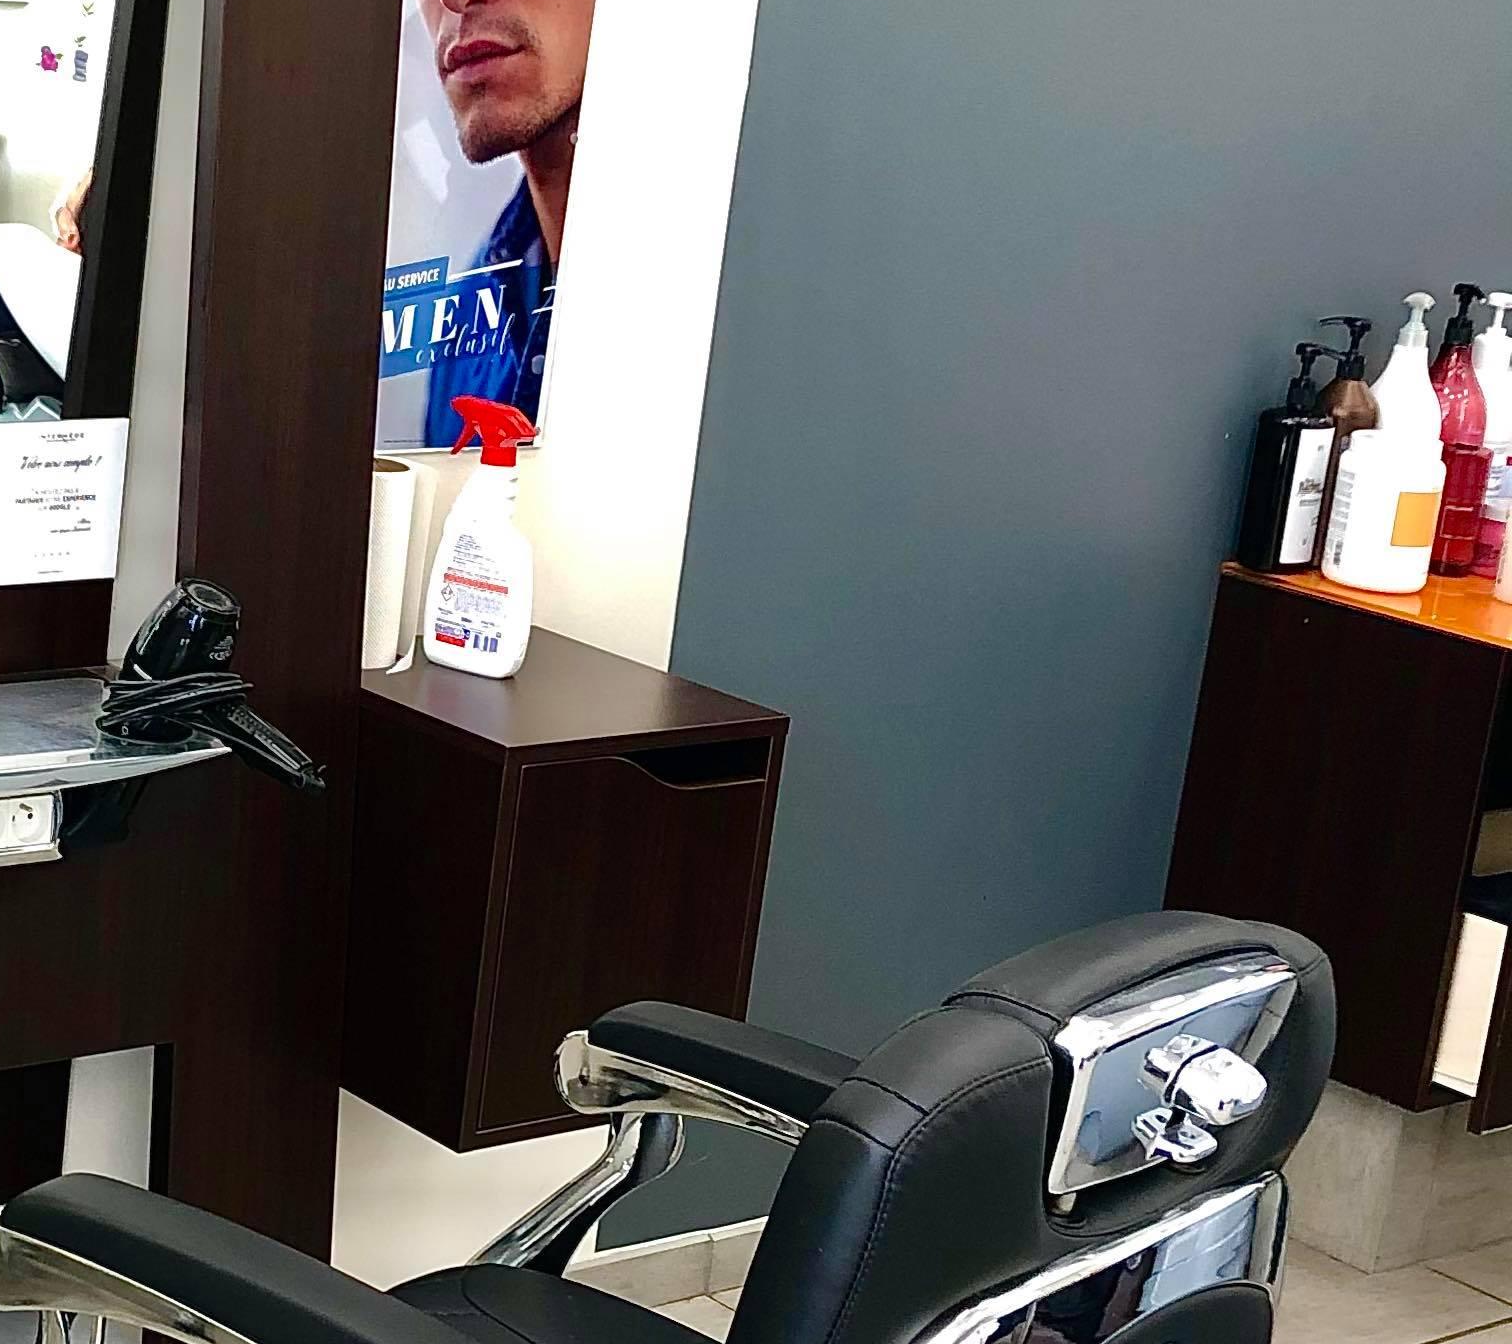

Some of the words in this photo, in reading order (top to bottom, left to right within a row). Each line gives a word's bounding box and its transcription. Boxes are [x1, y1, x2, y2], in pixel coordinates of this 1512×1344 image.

[396, 267, 441, 290] SERVICE
[381, 283, 508, 355] MEN
[415, 312, 517, 365] exclusif
